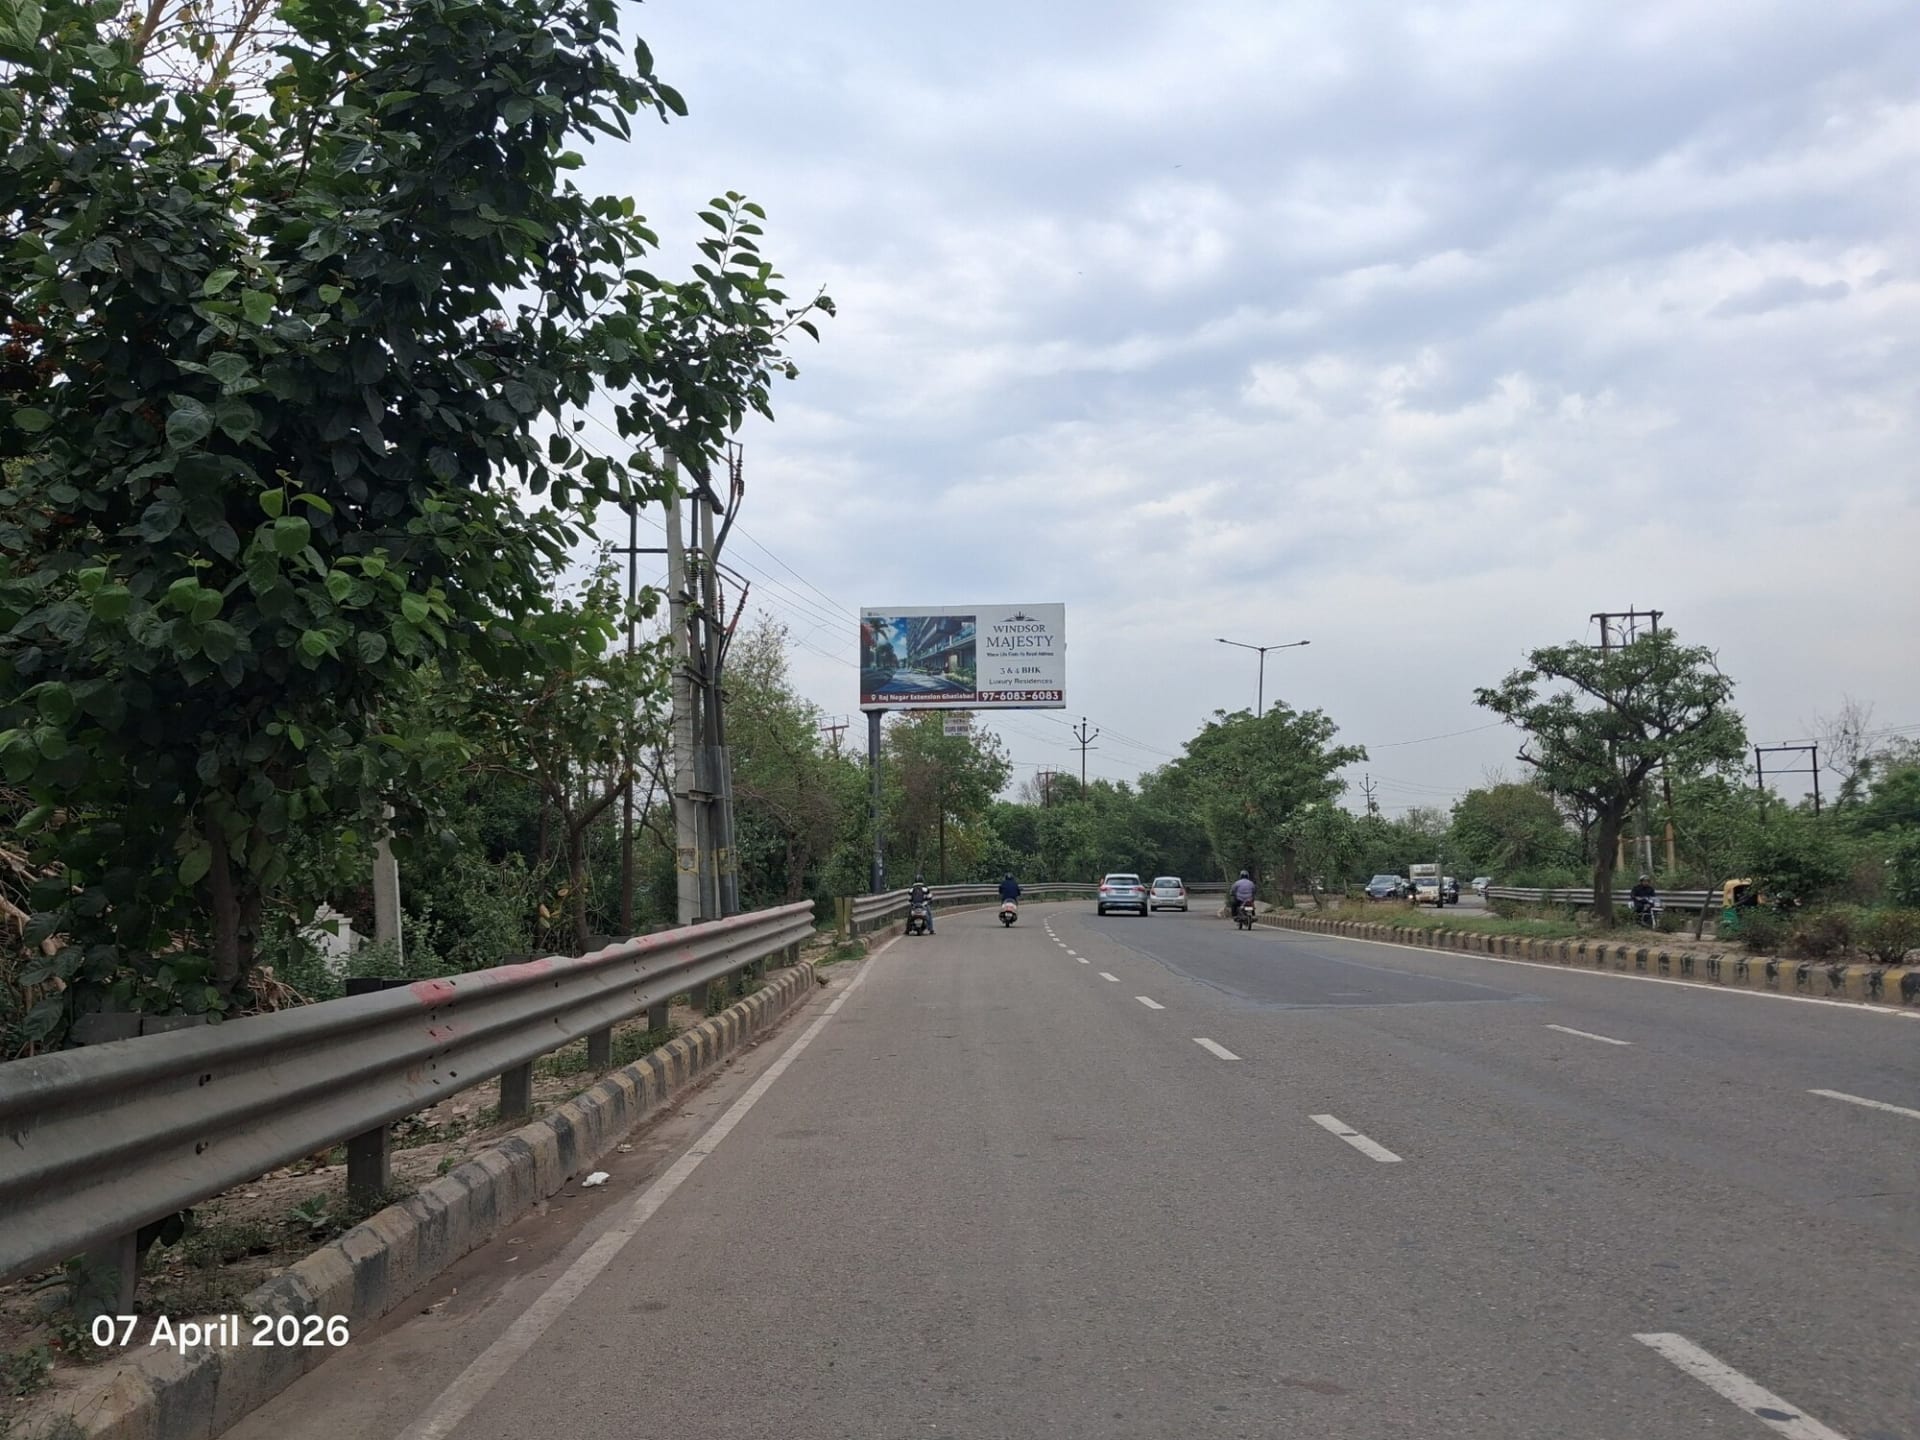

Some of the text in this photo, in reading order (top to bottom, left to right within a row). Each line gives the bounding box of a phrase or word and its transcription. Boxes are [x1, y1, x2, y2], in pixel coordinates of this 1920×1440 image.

[993, 624, 1046, 633] WINDSOR
[986, 635, 1054, 650] MAJESTY
[1022, 666, 1041, 674] BHK
[989, 677, 1013, 685] Luxury
[878, 694, 889, 702] Raj
[890, 694, 909, 702] Nagar
[982, 691, 1059, 701] 97-6083-6083
